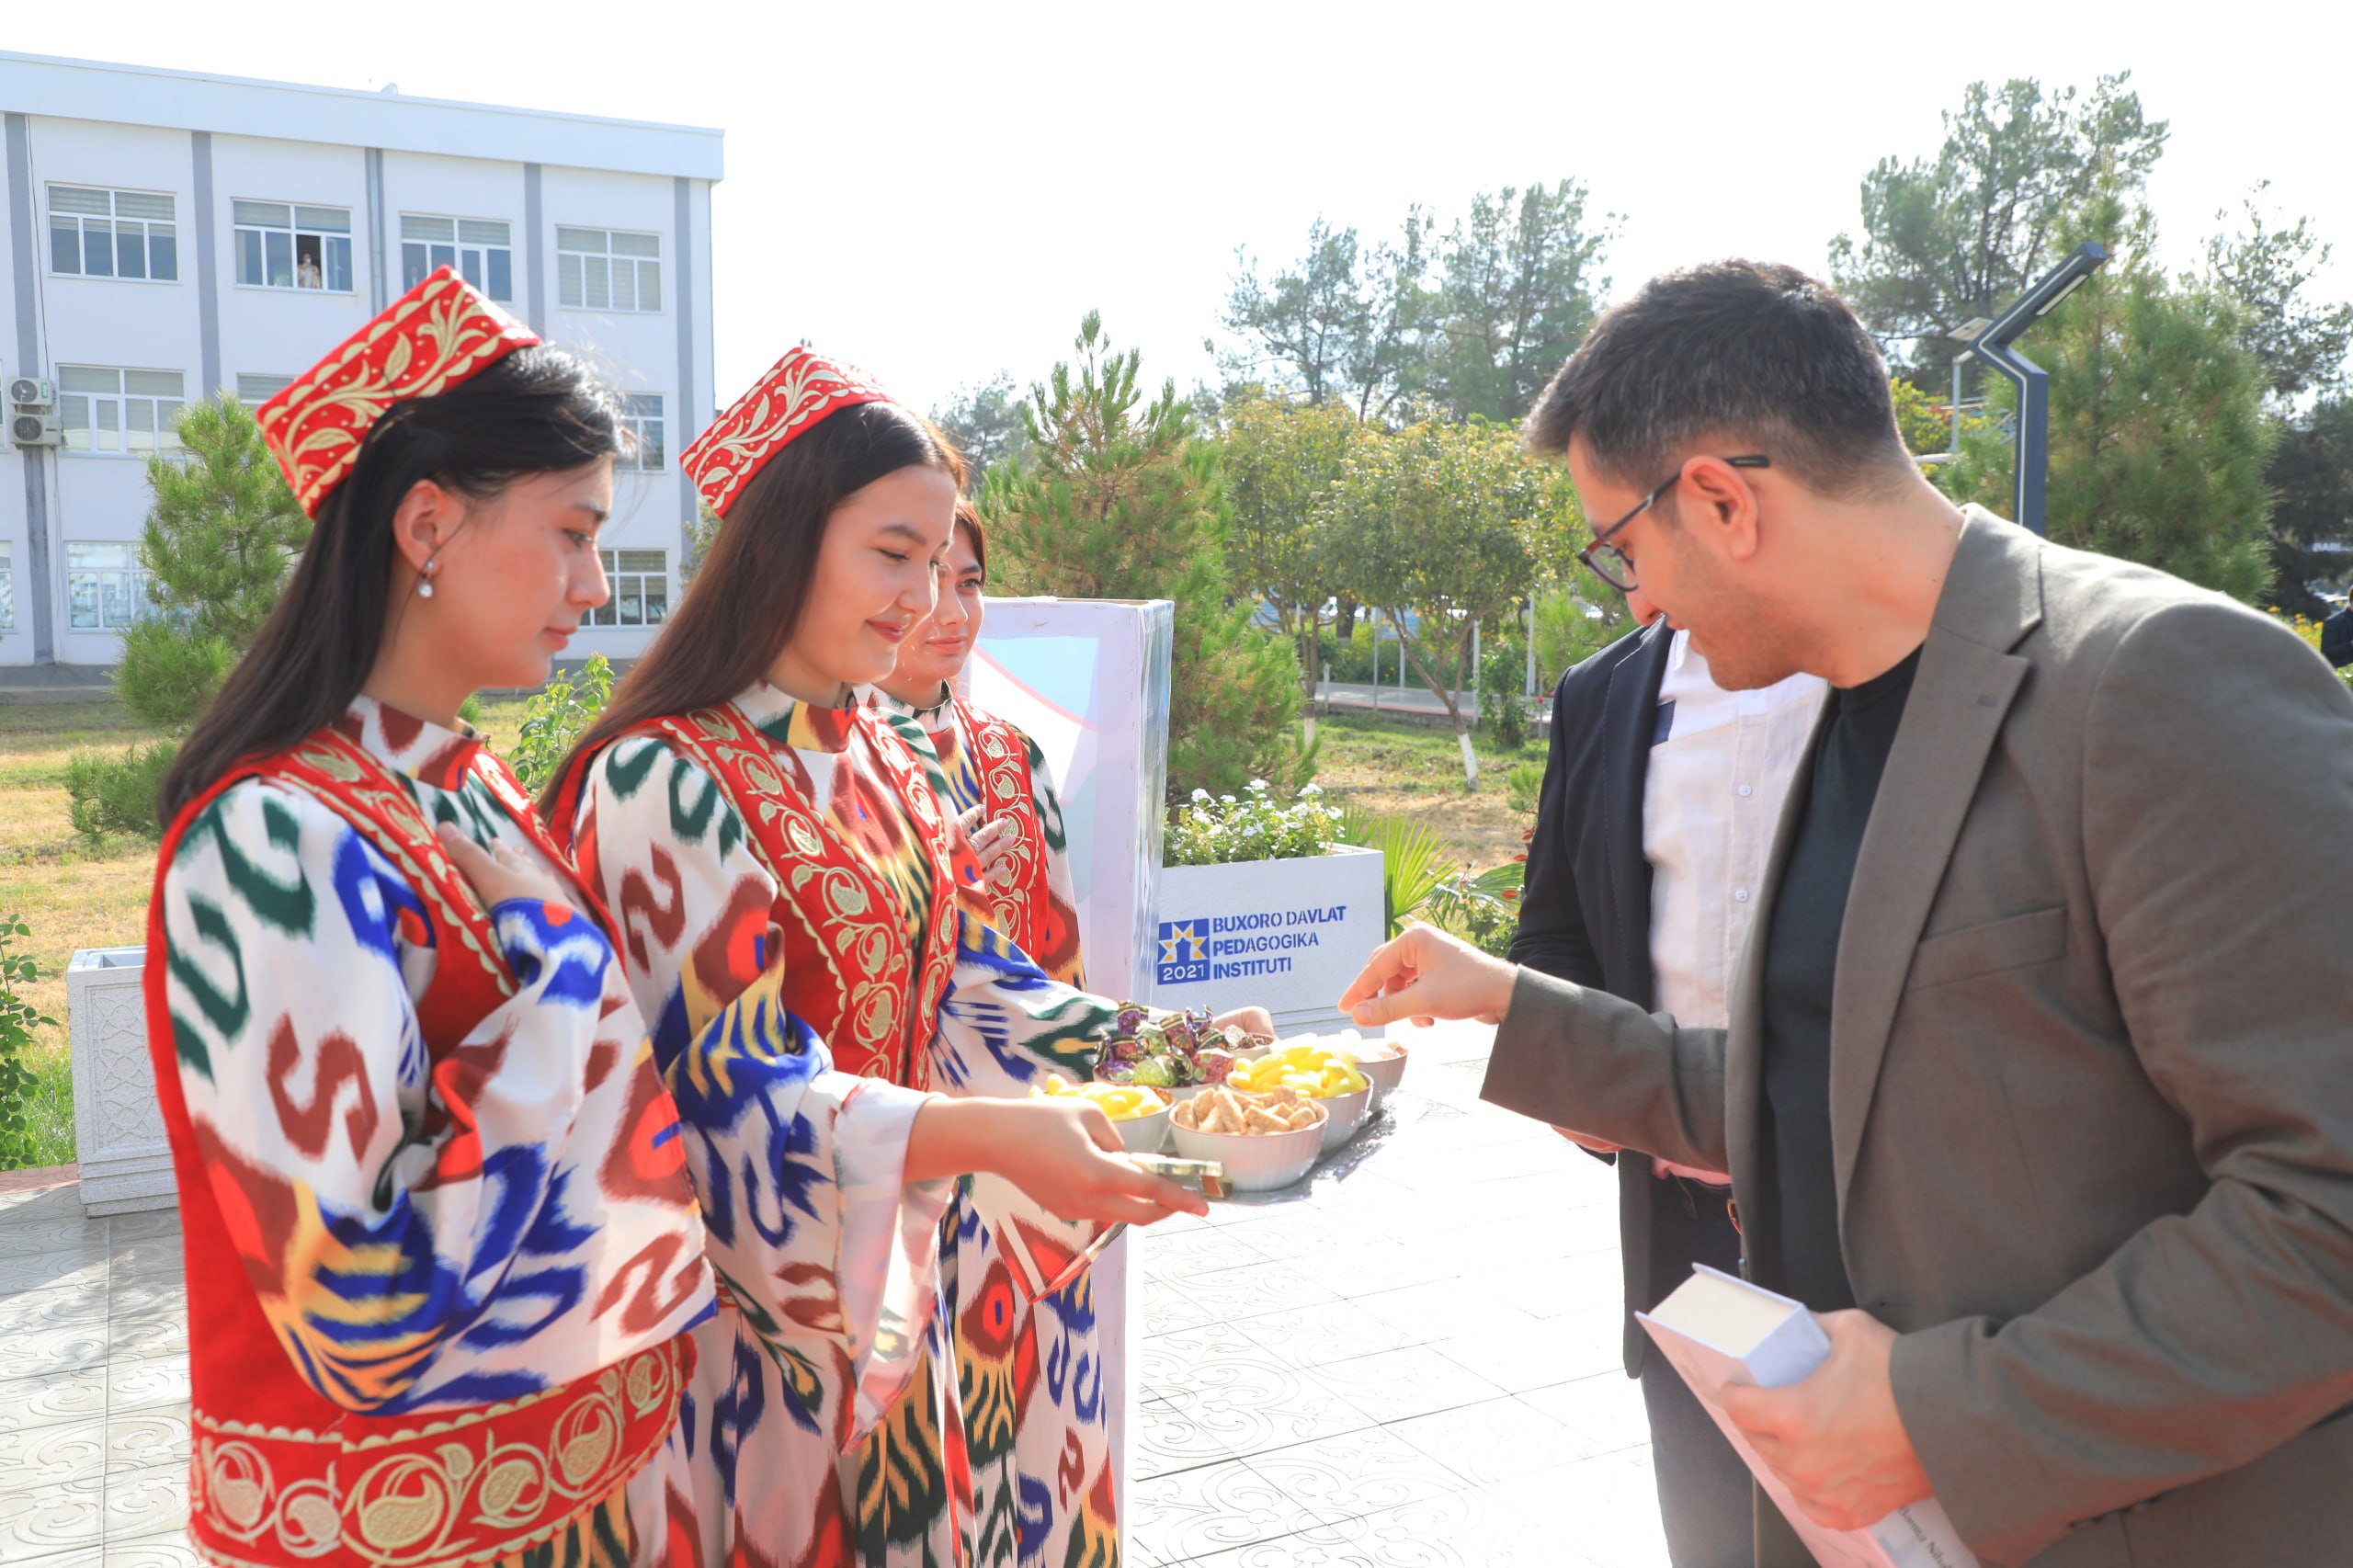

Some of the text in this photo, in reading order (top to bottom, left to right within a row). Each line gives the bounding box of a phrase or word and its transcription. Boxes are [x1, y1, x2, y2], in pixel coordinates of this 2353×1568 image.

[1212, 905, 1347, 933] BUXORO DAVLAT
[1212, 932, 1320, 957] PEDAGOGIKA
[1163, 963, 1205, 982] 2021
[1213, 957, 1291, 980] INSTITUTI
